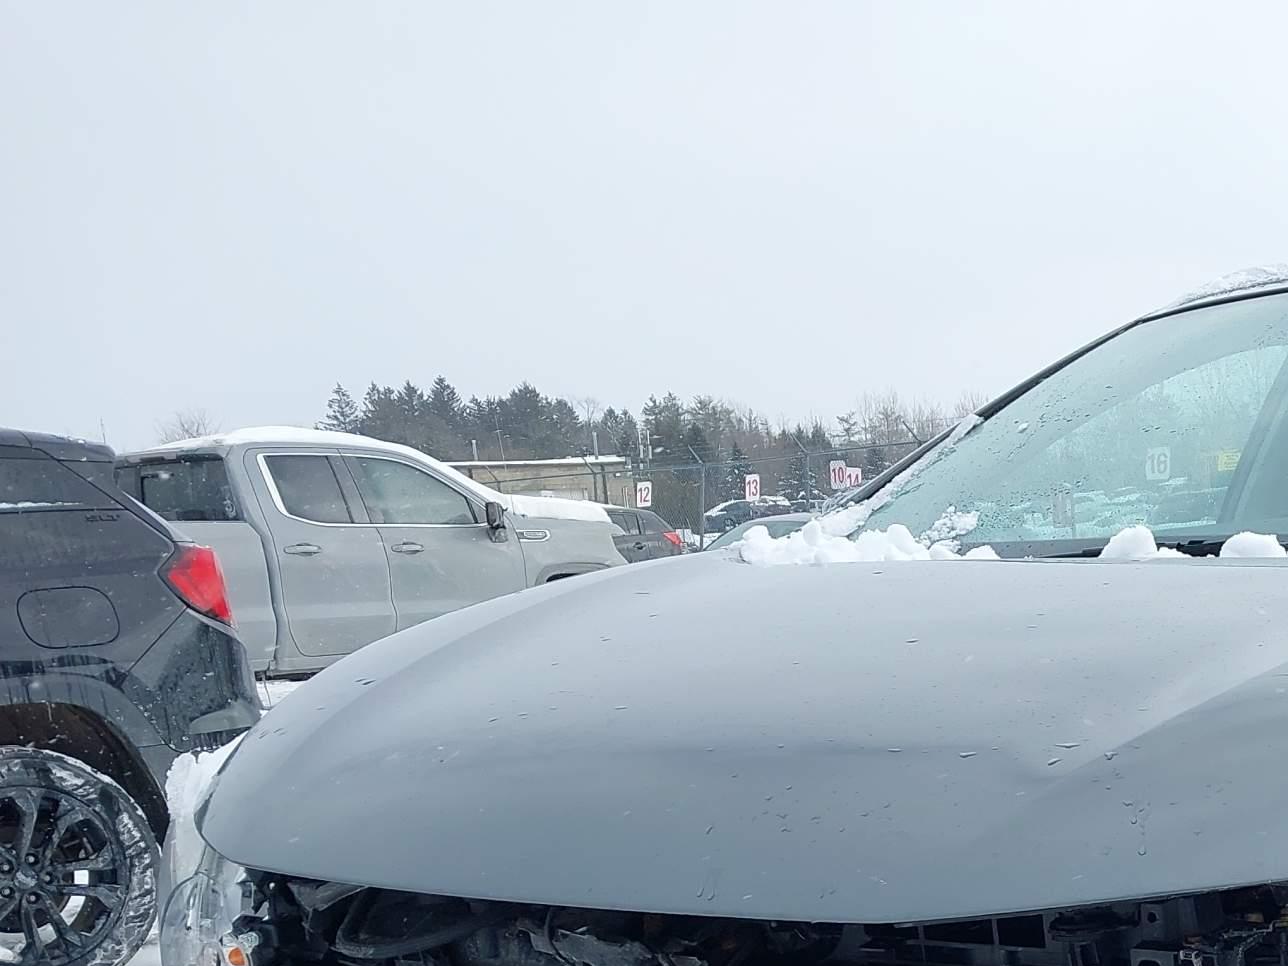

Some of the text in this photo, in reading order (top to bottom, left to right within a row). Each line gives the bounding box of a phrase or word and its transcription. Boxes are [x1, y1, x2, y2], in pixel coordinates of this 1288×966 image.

[1147, 453, 1168, 474] 16
[832, 466, 845, 484] 10
[638, 486, 650, 504] 12
[746, 479, 759, 497] 13
